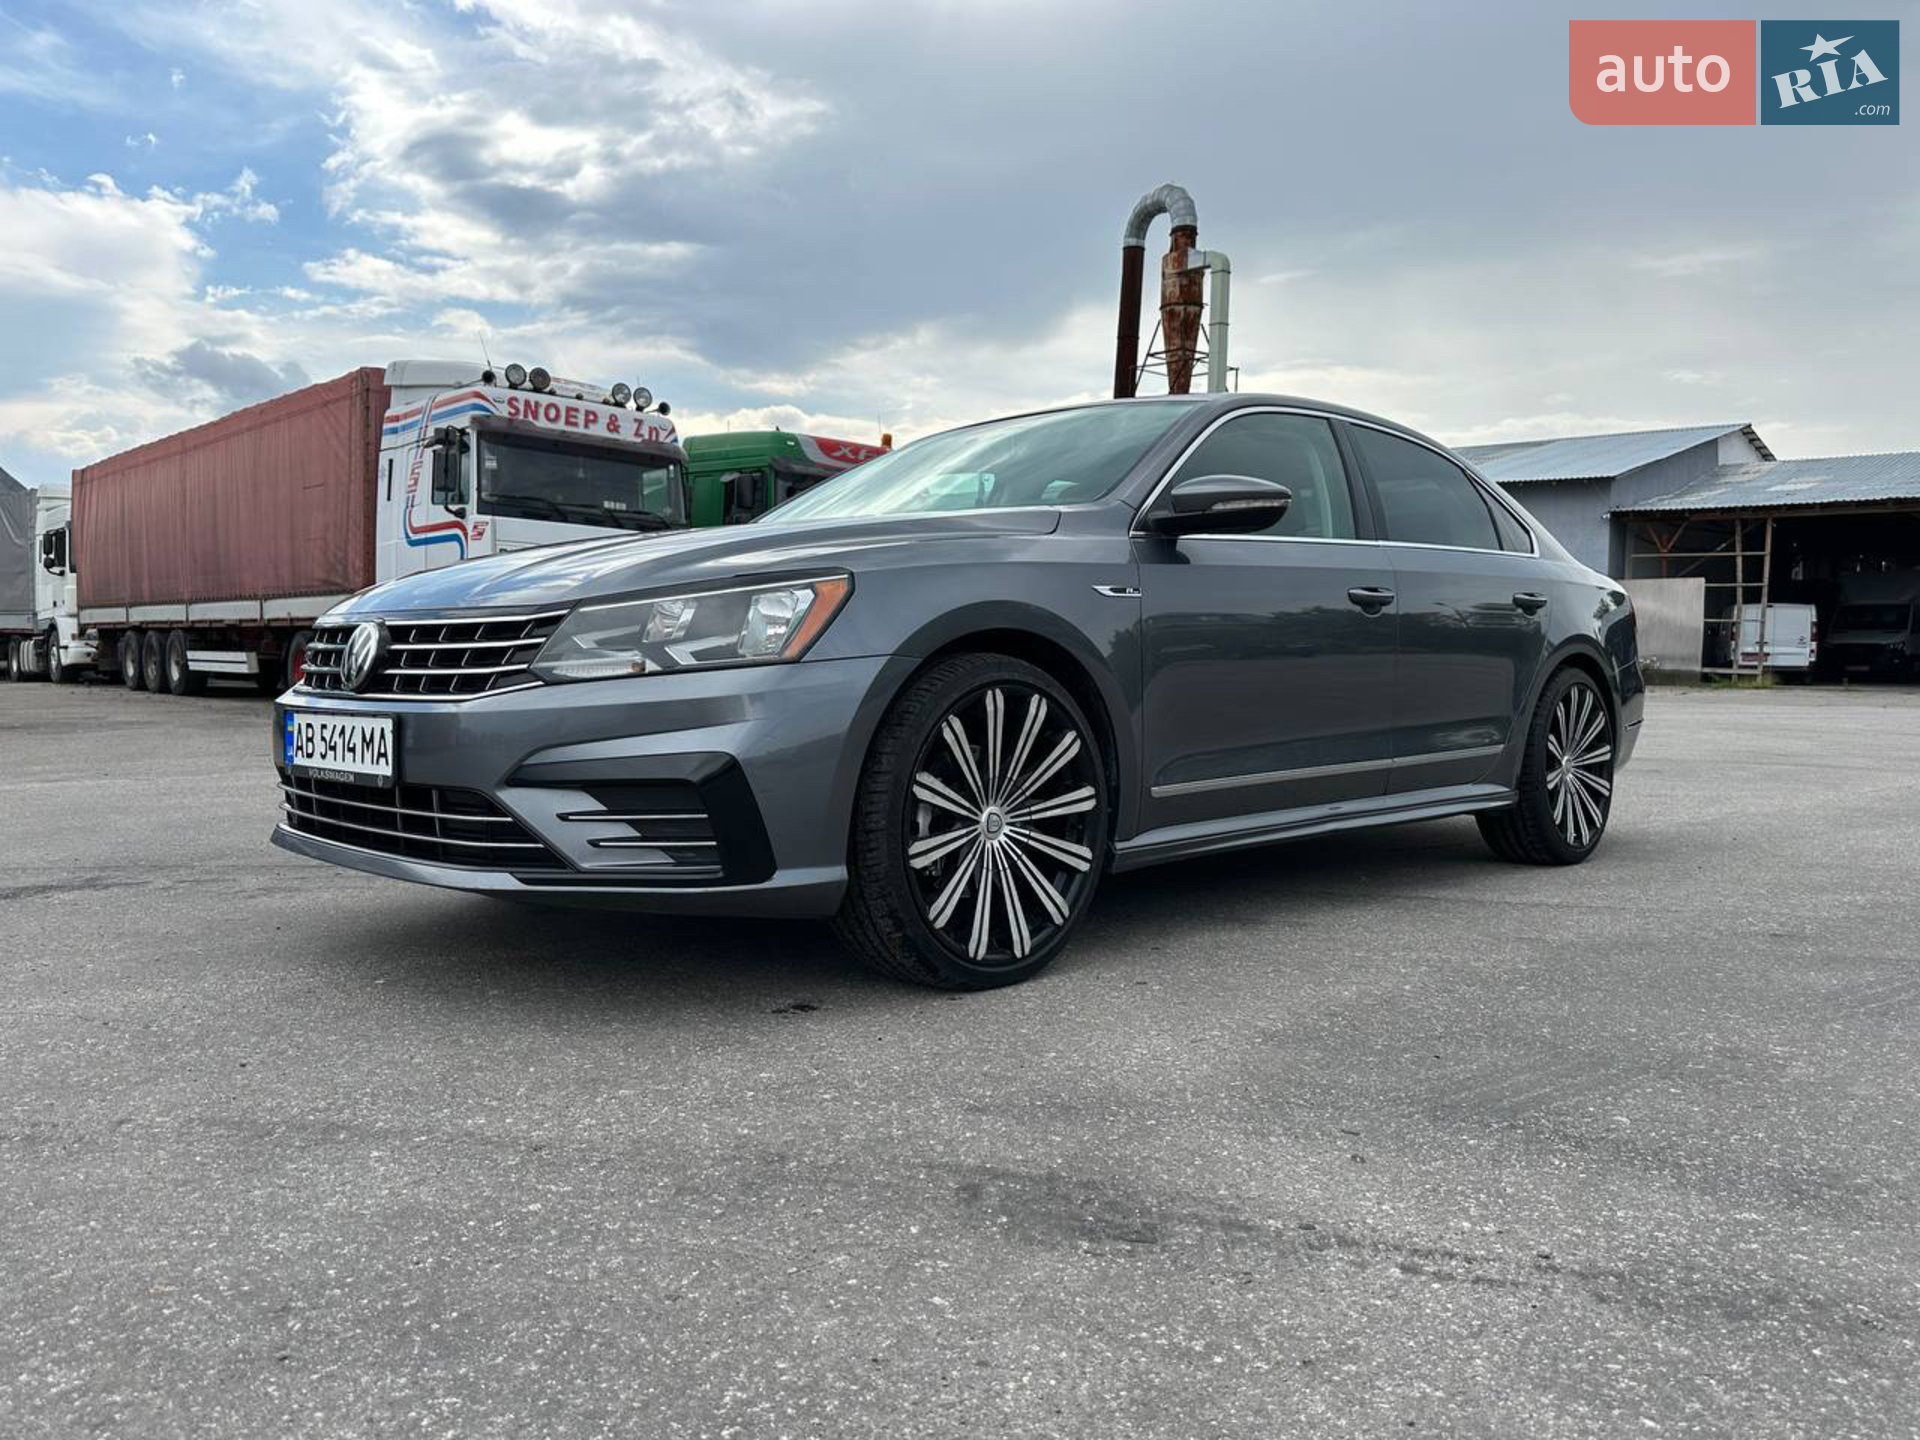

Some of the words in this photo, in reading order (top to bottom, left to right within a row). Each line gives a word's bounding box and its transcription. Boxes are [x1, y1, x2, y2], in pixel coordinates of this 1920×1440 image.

[506, 396, 599, 429] SNOEP
[606, 413, 621, 434] &
[308, 767, 355, 783] VOLKSWAGEN
